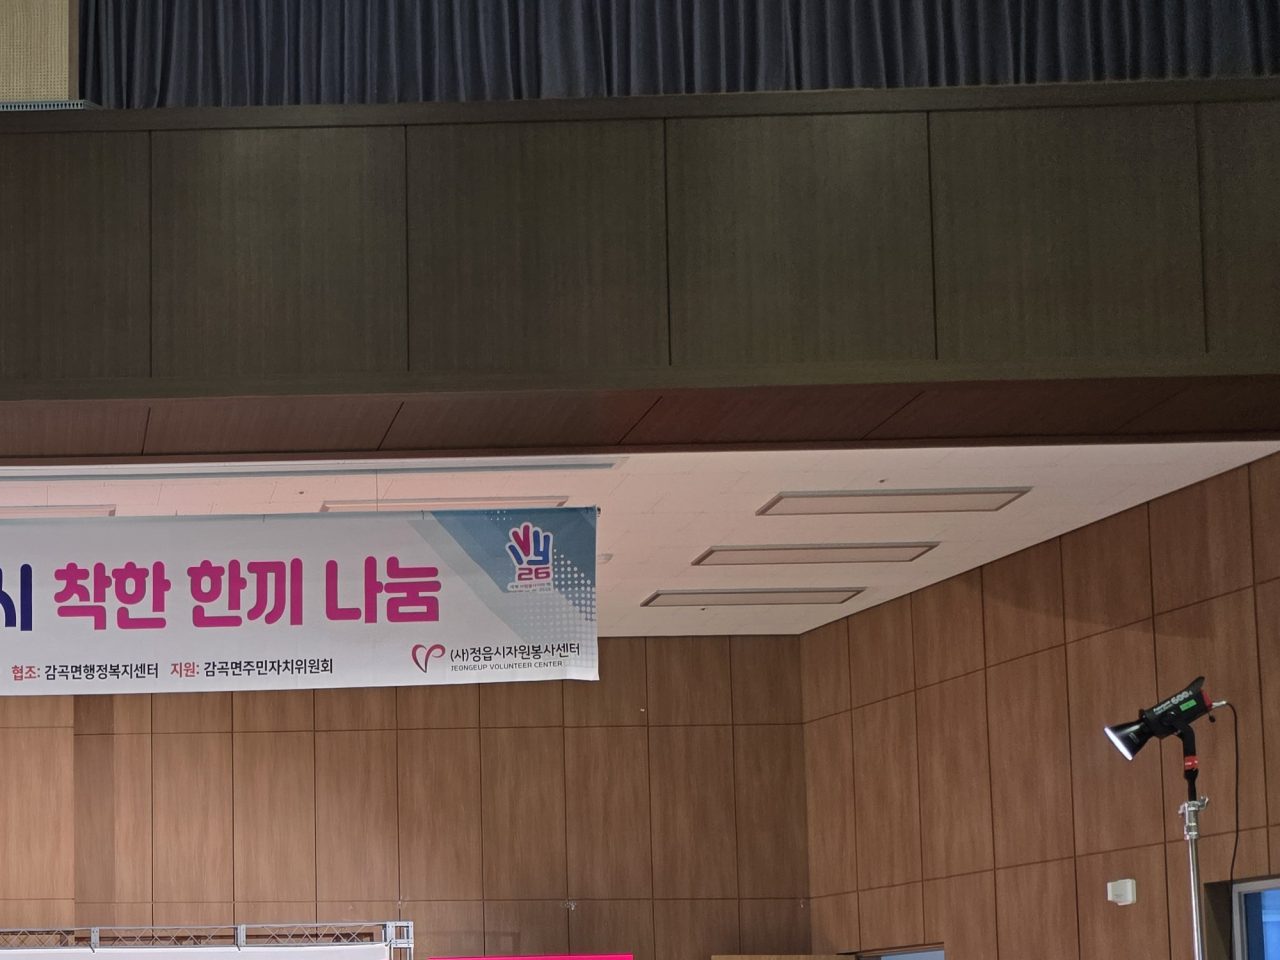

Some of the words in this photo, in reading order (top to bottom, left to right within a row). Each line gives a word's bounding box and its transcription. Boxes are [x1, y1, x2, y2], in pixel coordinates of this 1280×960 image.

[518, 566, 550, 581] 26
[54, 561, 171, 630] 착한
[187, 558, 303, 628] 한끼
[325, 556, 442, 624] 나눔
[450, 642, 580, 662] (사)정읍시자원봉사센터
[11, 664, 40, 681] 협조:
[44, 663, 159, 680] 감곡면행정복지센터
[170, 661, 200, 678] 지원:
[203, 658, 333, 677] 감곡면주민자치위원회
[451, 664, 487, 672] JEONGEUP
[490, 662, 532, 671] VOLUNTEER
[534, 661, 563, 669] CENTER
